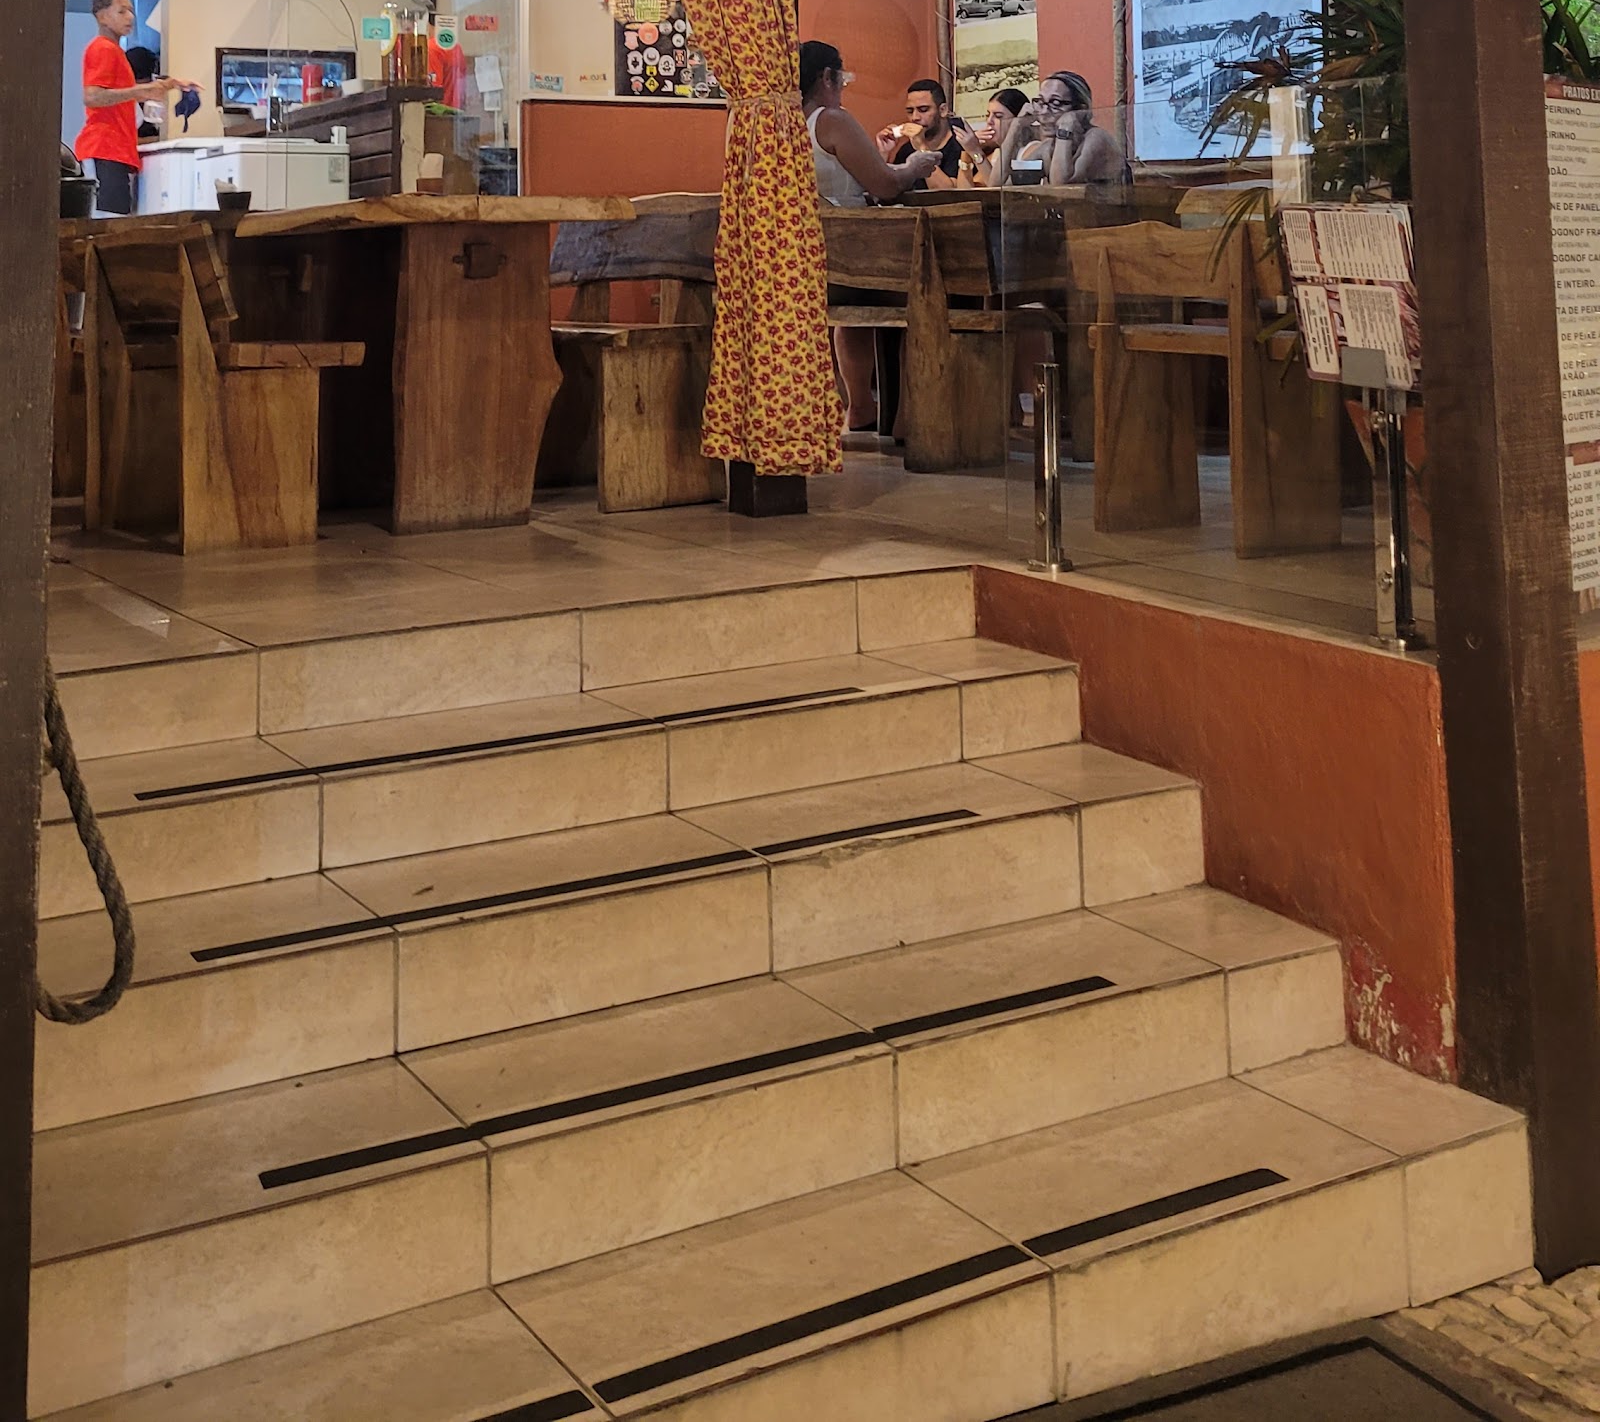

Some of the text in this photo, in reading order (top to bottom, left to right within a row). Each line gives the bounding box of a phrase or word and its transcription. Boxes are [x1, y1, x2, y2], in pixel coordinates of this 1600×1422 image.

[1562, 85, 1590, 100] PRATOS
[1546, 130, 1576, 140] IRINHO
[1548, 166, 1568, 176] DÃO
[1563, 202, 1574, 211] DE
[1564, 279, 1595, 289] INTEIRO
[1568, 306, 1579, 315] DE
[1561, 333, 1572, 342] DE
[1563, 361, 1573, 370] DE
